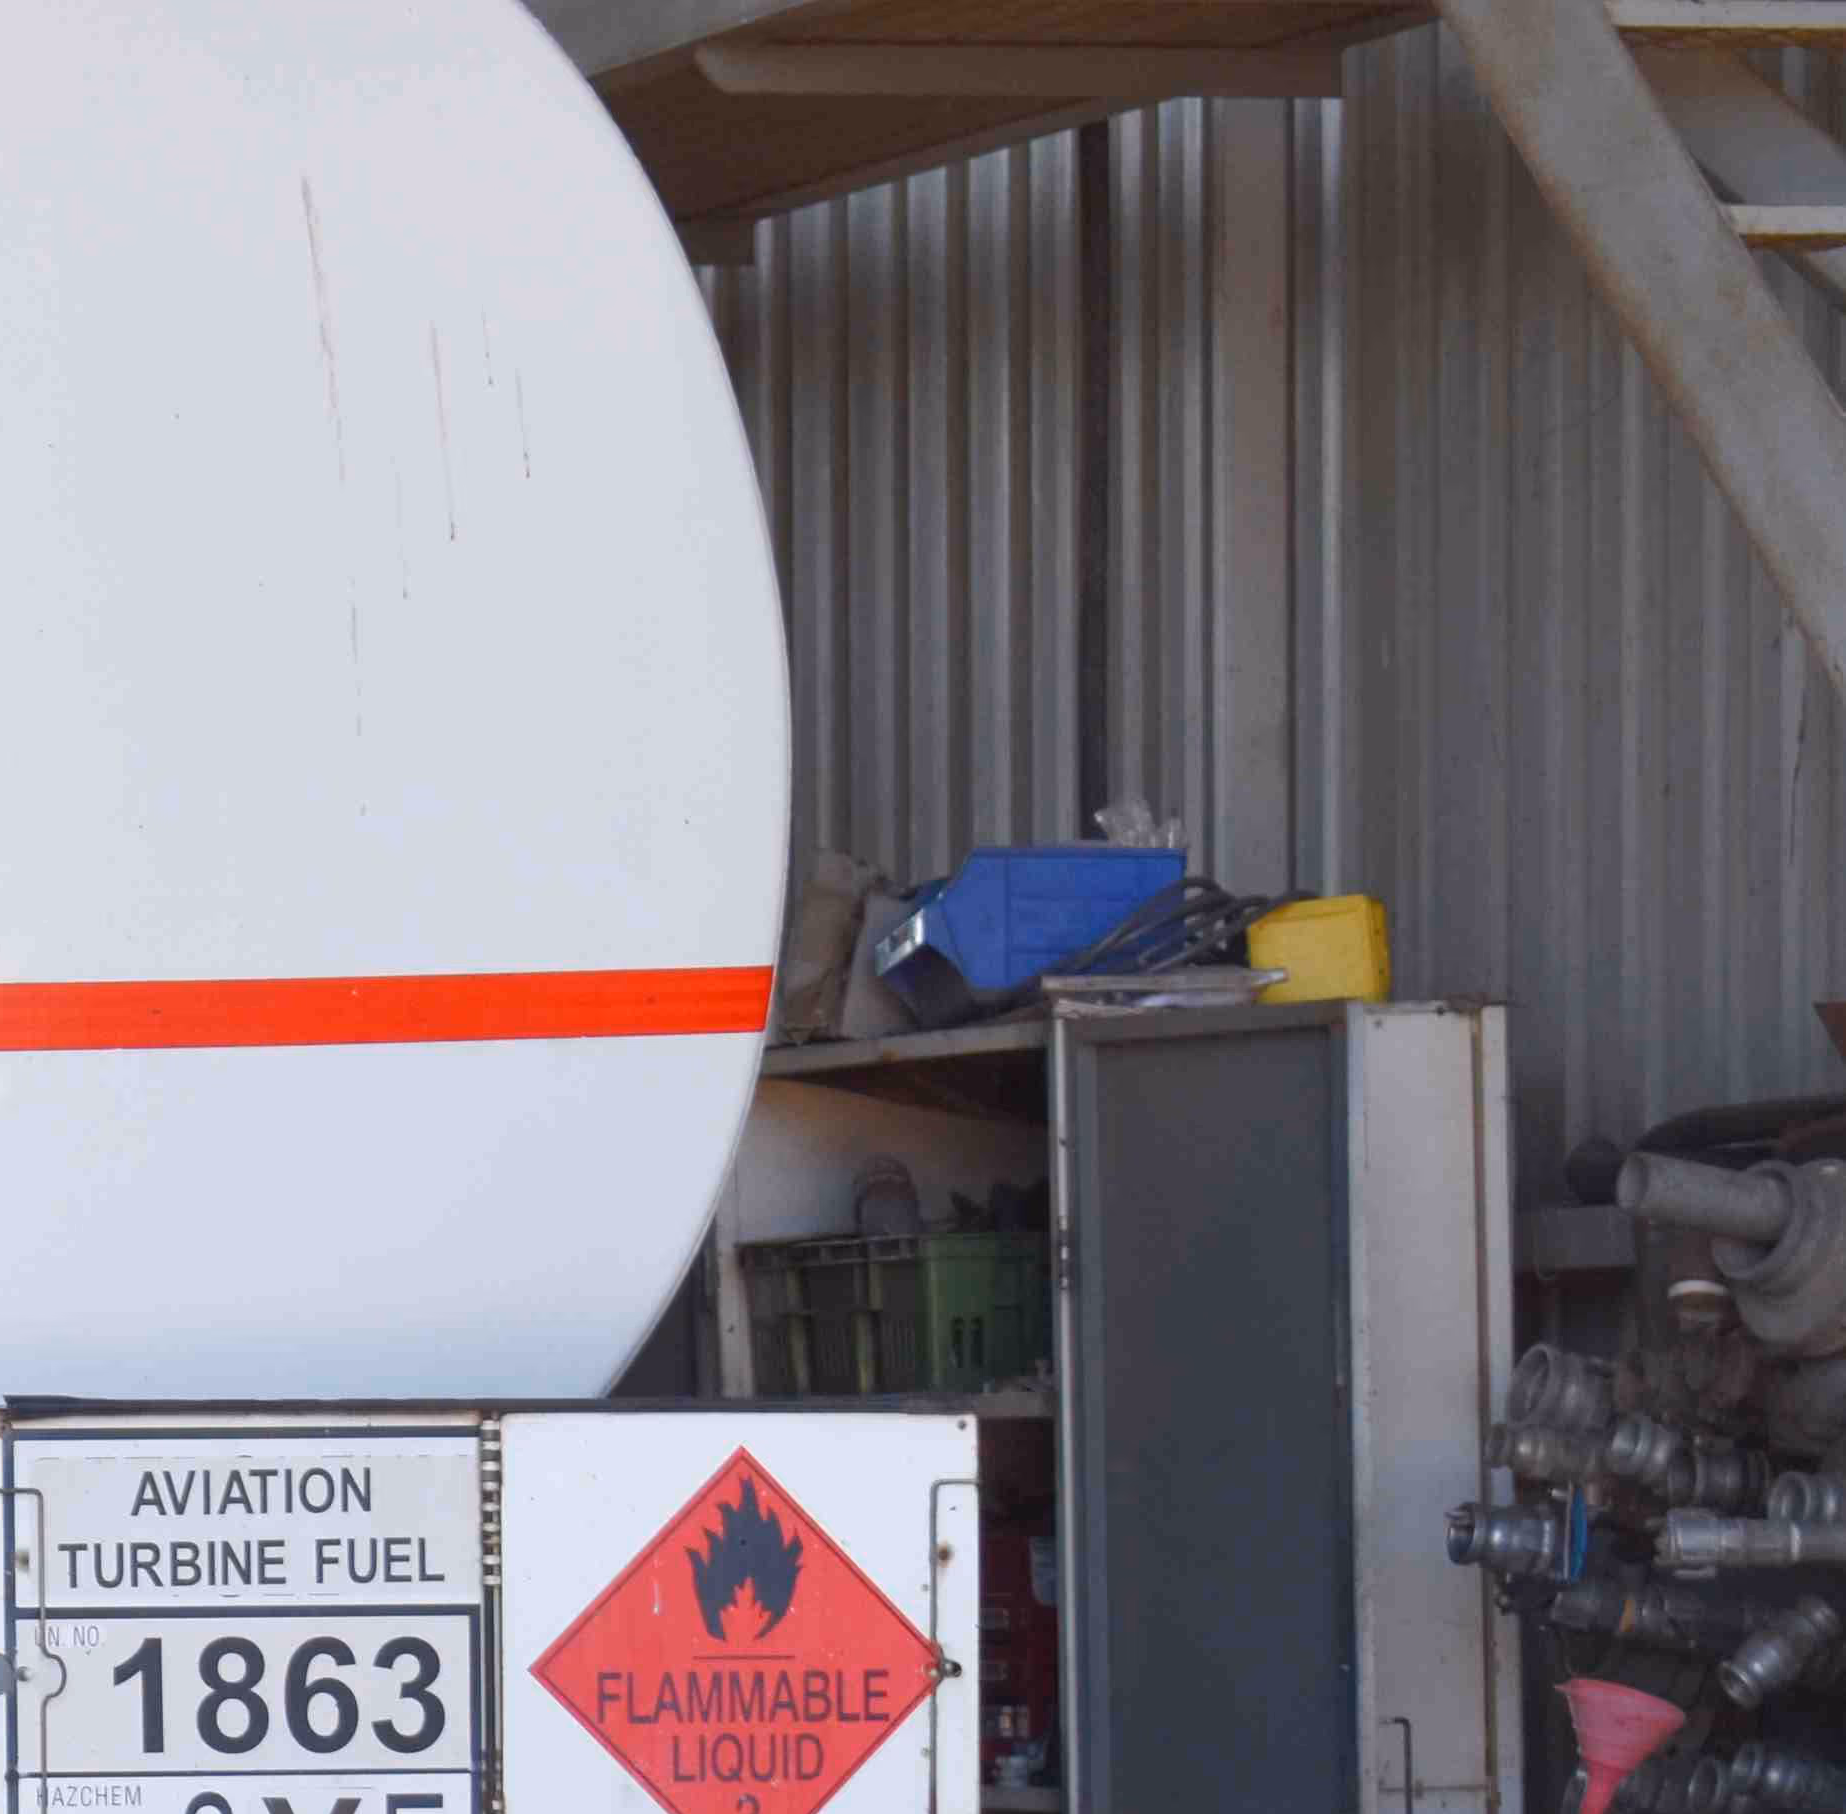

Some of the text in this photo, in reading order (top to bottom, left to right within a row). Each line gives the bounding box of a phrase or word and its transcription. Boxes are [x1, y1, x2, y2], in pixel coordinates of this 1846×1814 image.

[131, 1466, 374, 1517] AVIATION
[59, 1537, 445, 1589] TURBINE FUEL
[113, 1636, 447, 1755] 1863
[596, 1669, 890, 1724] FLAMMABLE
[672, 1734, 824, 1783] LIQUID
